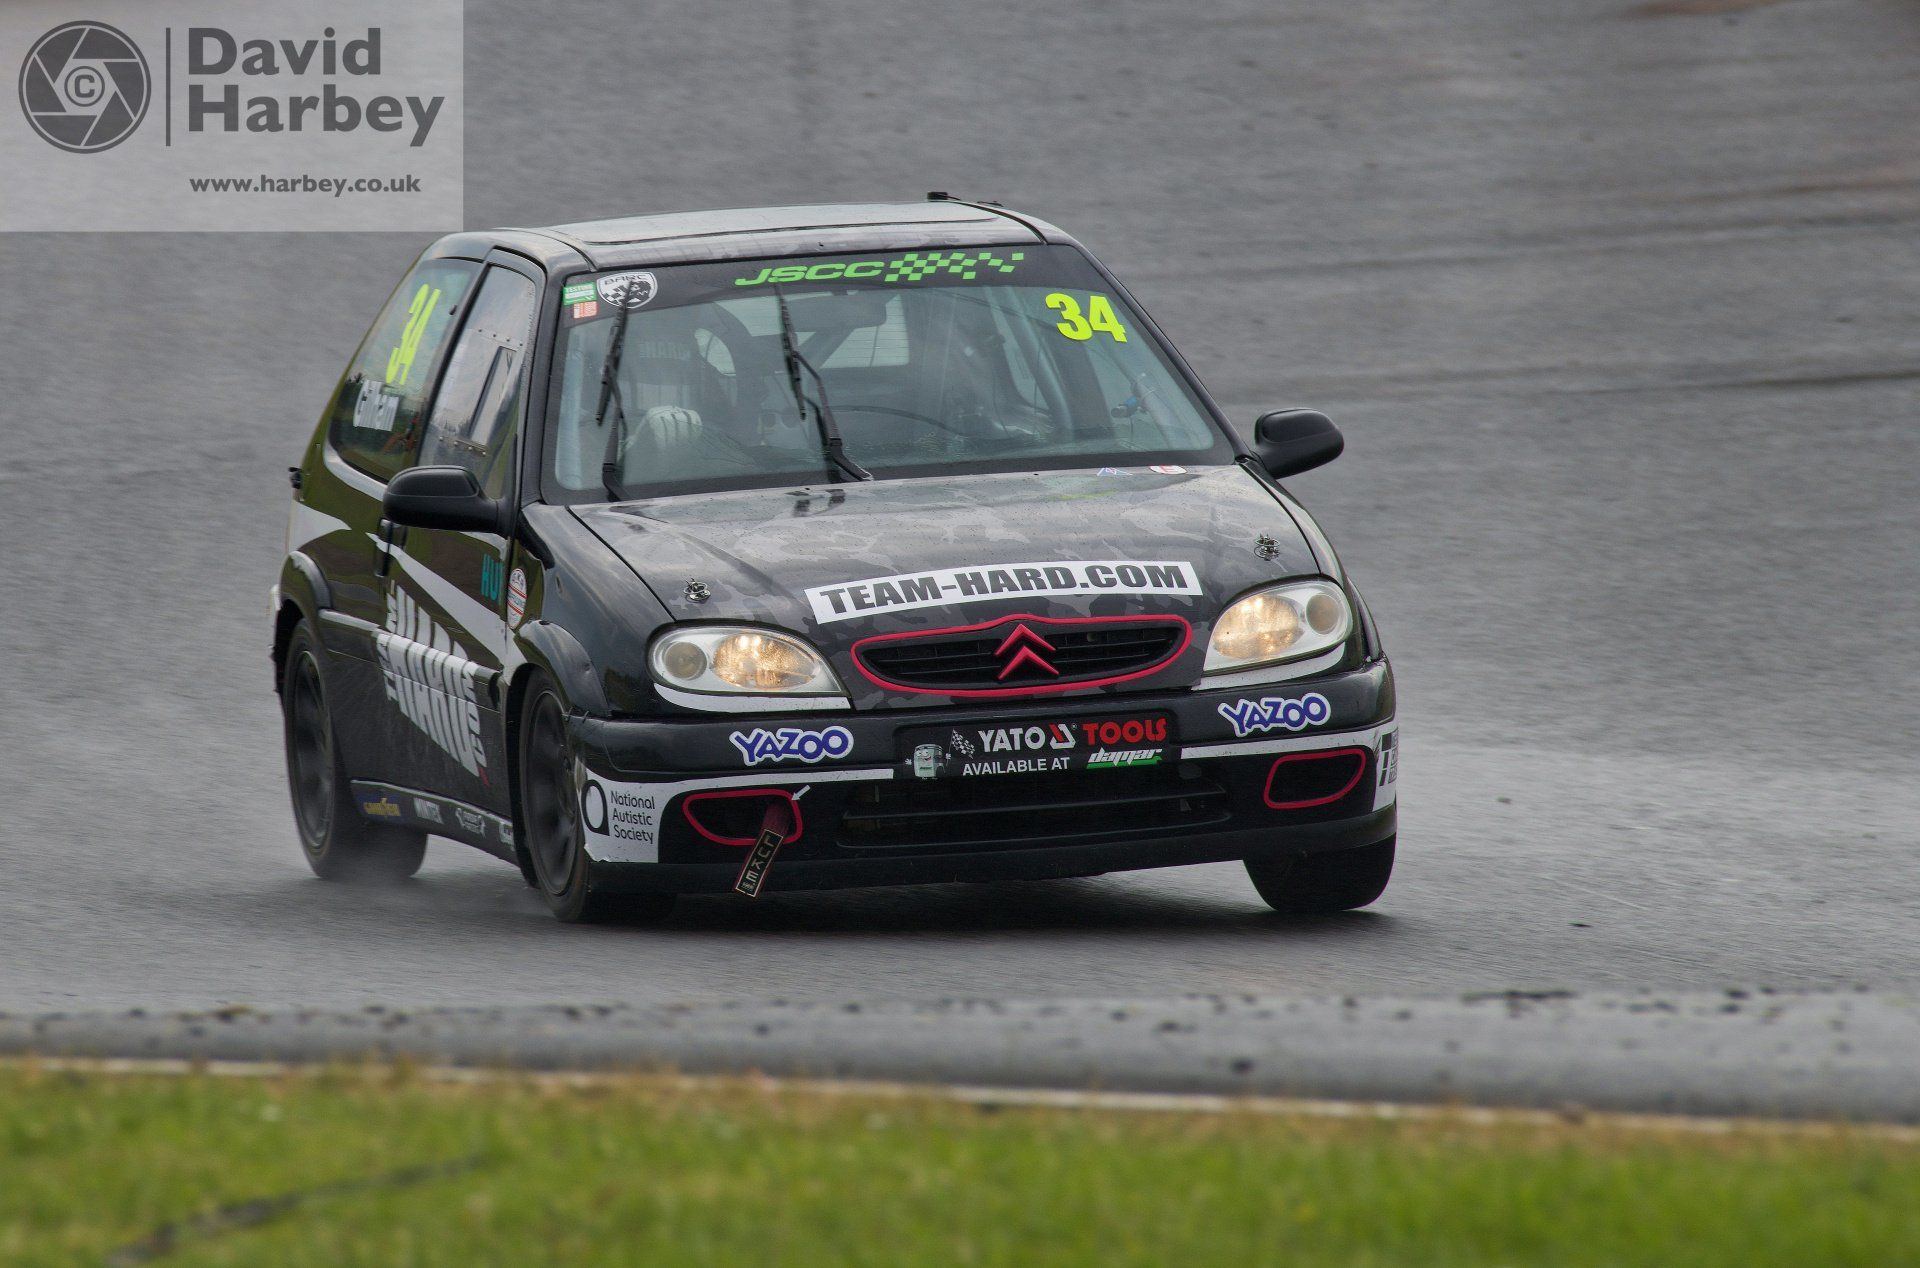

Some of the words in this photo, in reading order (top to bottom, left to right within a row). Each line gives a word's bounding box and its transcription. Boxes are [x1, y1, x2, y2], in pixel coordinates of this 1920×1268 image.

[734, 261, 886, 286] JSCC
[1045, 292, 1128, 343] 34
[820, 564, 1188, 614] TEAM-HARD.COM
[1220, 695, 1329, 735] YAZOO
[731, 727, 852, 764] YAZOO
[978, 726, 1046, 752] YATO
[1082, 718, 1167, 746] TOOLS
[962, 758, 1047, 776] AVAILABLE
[1051, 756, 1070, 771] AT
[1087, 747, 1163, 767] damar
[610, 790, 656, 810] National
[612, 807, 654, 826] Autistic
[613, 824, 654, 845] Society
